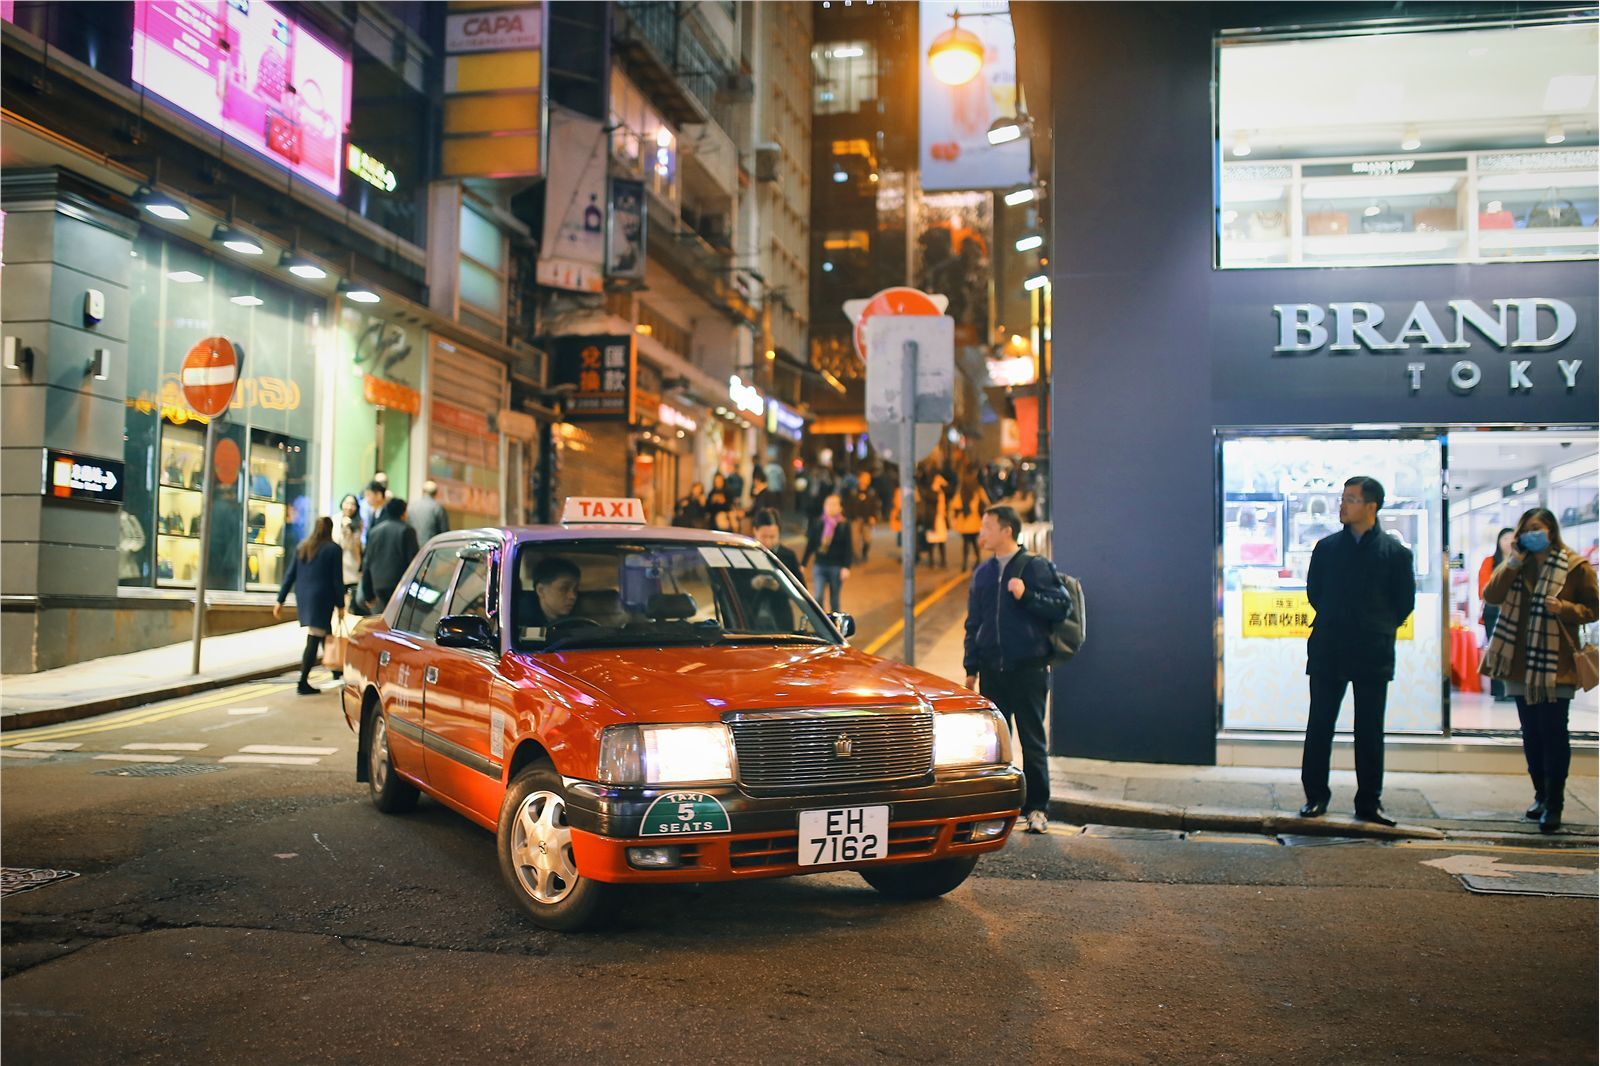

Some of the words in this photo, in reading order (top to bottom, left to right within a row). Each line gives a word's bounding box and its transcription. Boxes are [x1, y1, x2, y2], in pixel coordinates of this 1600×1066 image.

[463, 14, 524, 36] CAPA
[1273, 298, 1577, 351] BRAND
[1407, 359, 1583, 391] TOKY
[579, 501, 633, 517] TAXI
[1249, 613, 1308, 627] 高價收購
[666, 794, 703, 804] TAXI
[677, 803, 695, 821] 5
[826, 809, 864, 835] EH
[659, 821, 713, 832] SEATS
[810, 836, 877, 863] 7162
